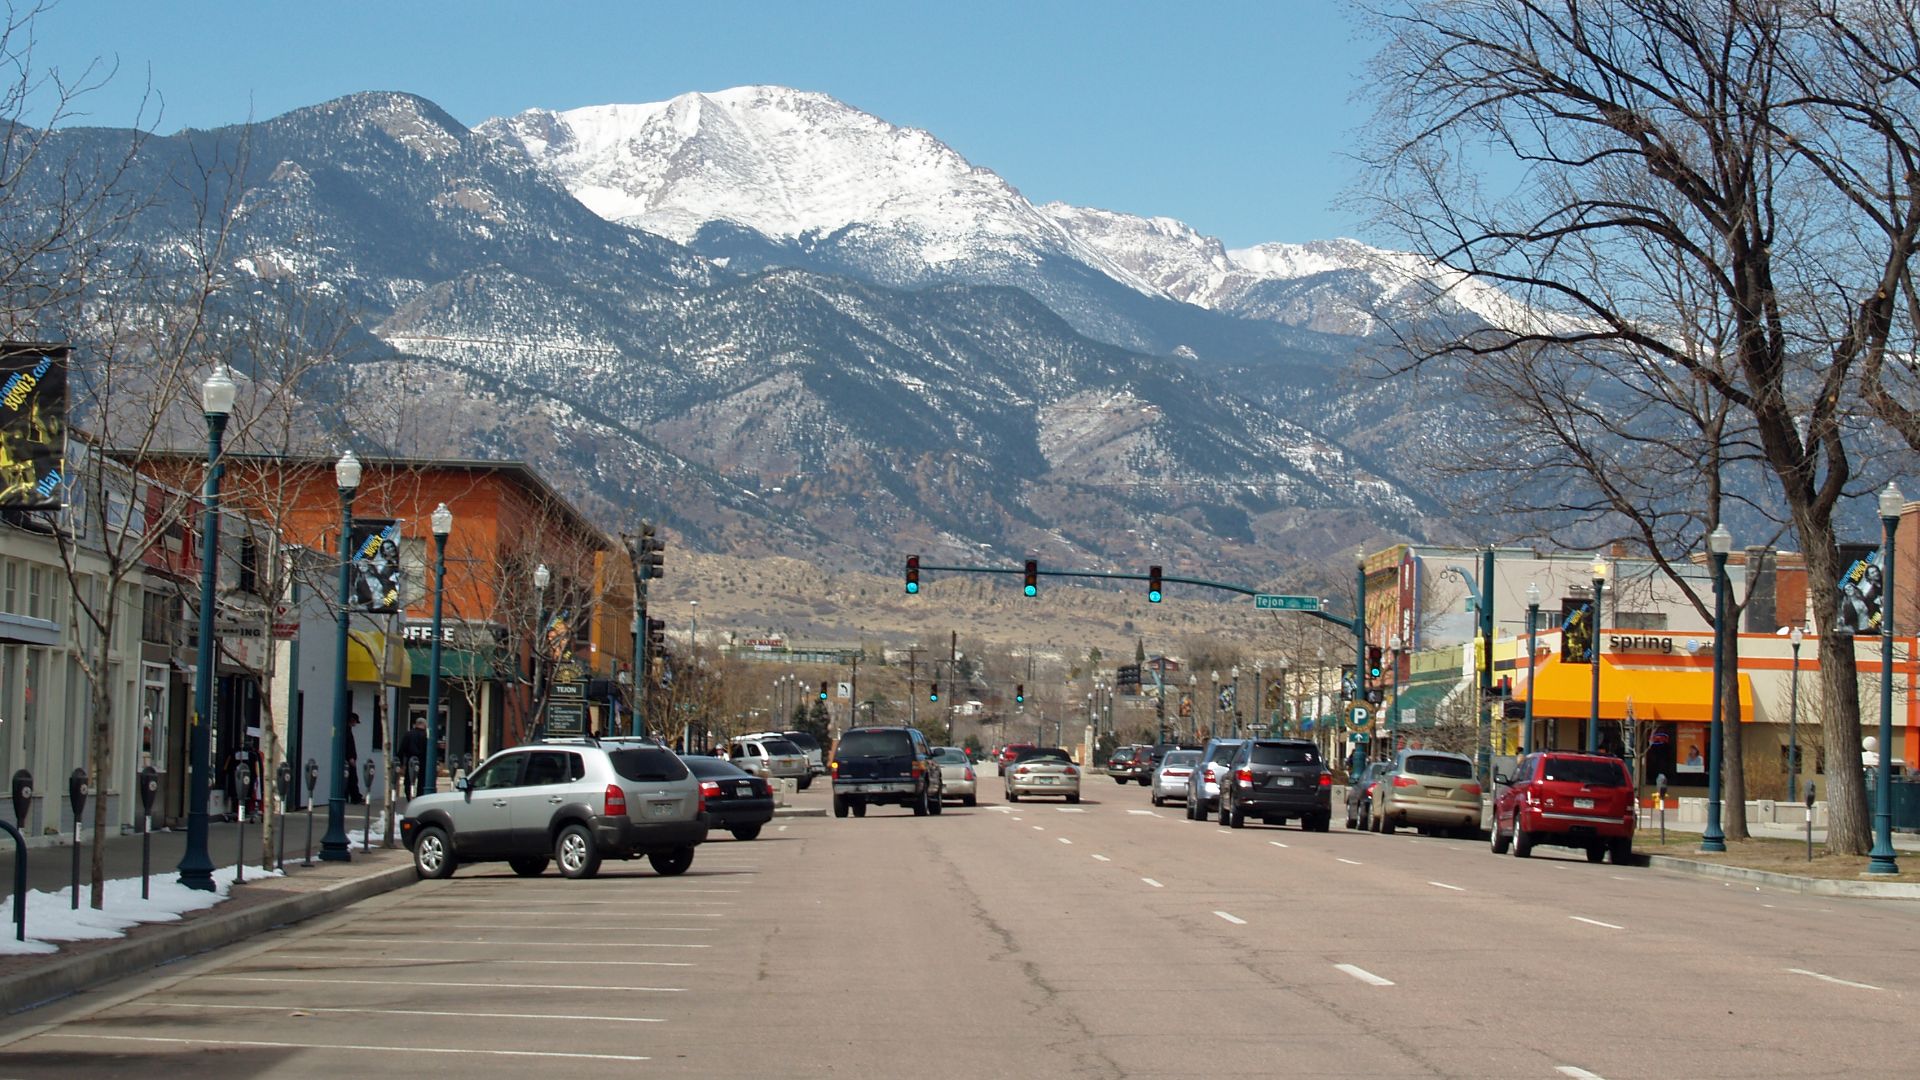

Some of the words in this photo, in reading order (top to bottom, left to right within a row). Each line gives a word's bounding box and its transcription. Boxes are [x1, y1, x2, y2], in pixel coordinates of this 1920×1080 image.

[1257, 596, 1284, 608] Tejon
[1609, 634, 1672, 653] spring
[1354, 707, 1367, 724] P
